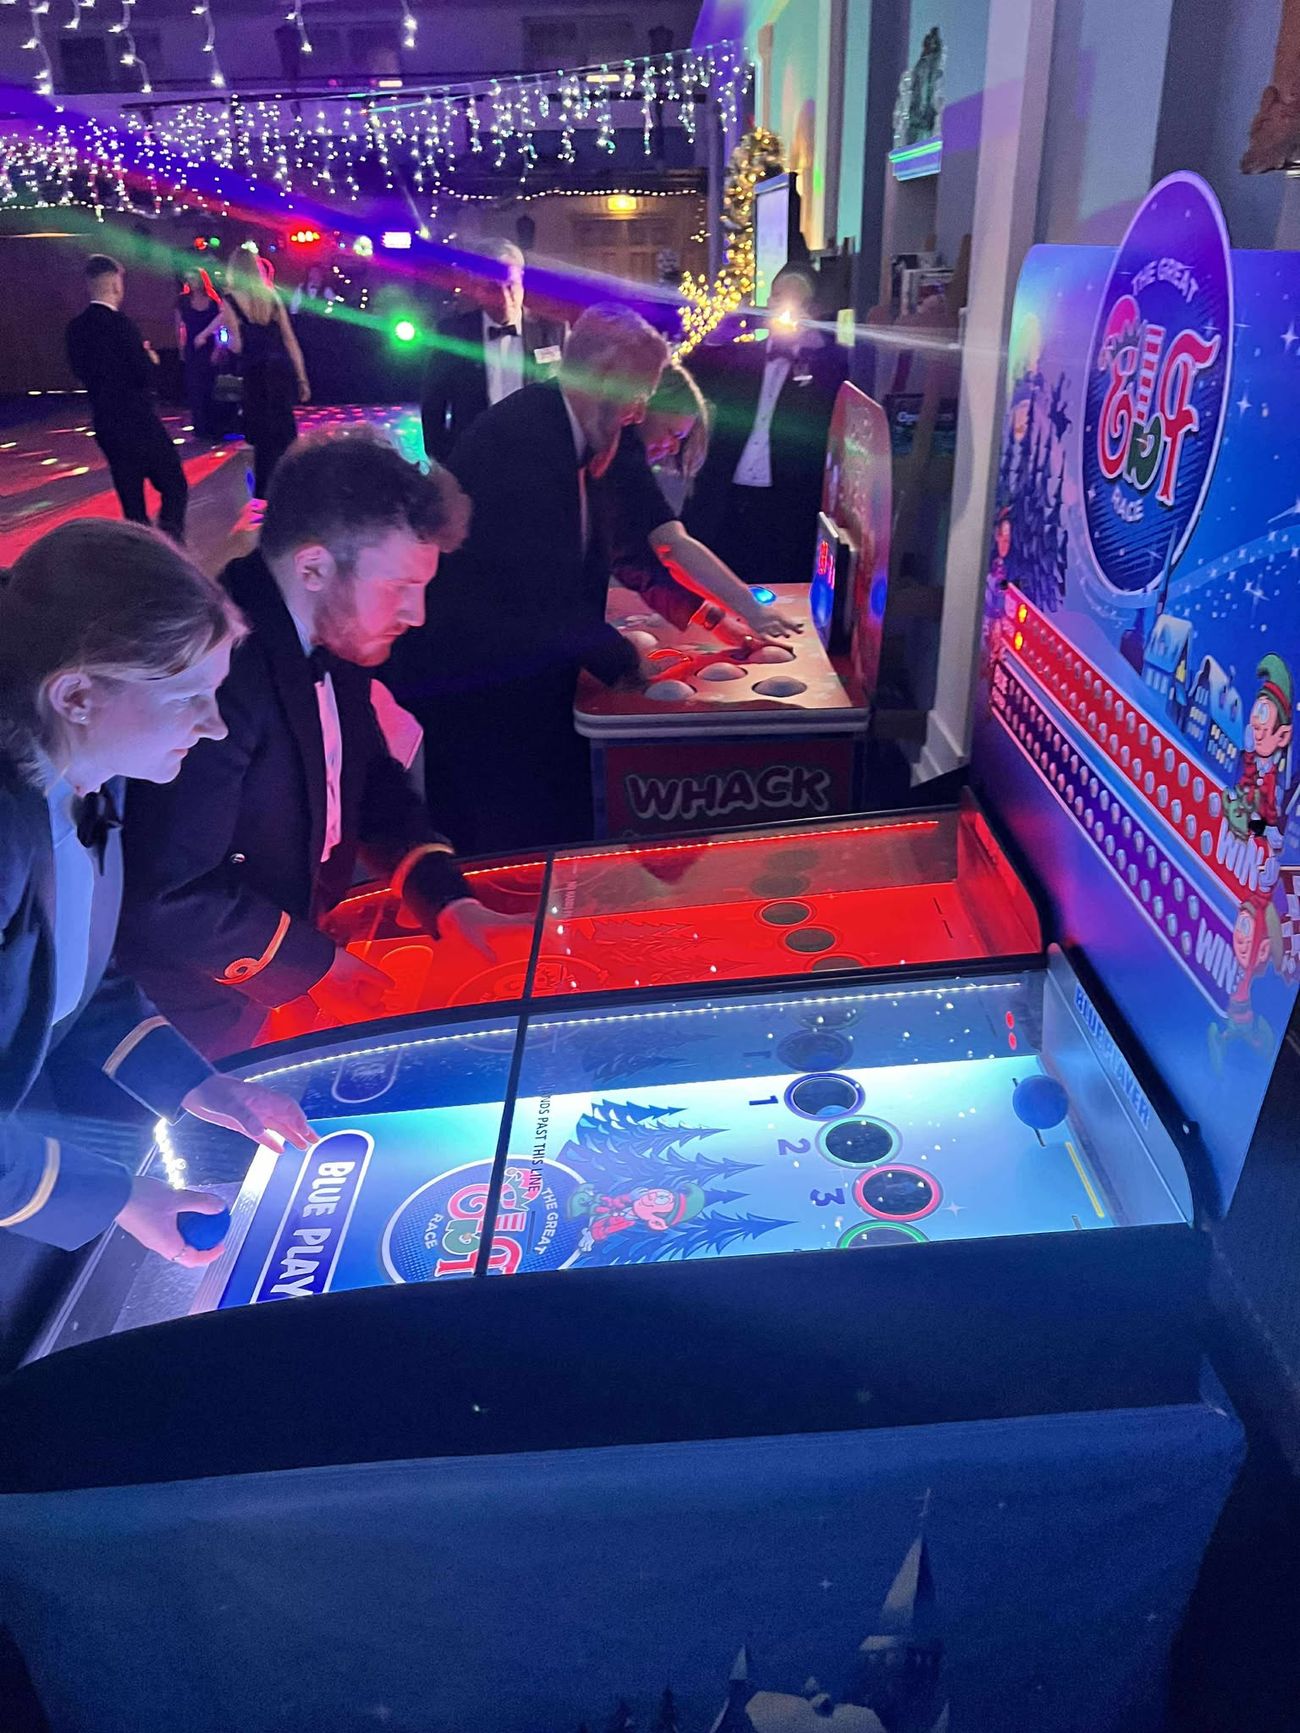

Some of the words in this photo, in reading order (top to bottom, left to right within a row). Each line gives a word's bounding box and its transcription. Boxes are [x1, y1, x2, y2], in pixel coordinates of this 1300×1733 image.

[1131, 260, 1158, 296] THE
[1157, 257, 1199, 303] GREAT
[1111, 486, 1144, 522] RACE
[626, 765, 831, 820] WHACK
[749, 1095, 778, 1106] 1
[535, 1116, 549, 1140] PAST
[532, 1143, 546, 1166] THIS
[777, 1138, 811, 1156] 2
[302, 1161, 356, 1218] BLUE
[528, 1168, 543, 1192] LINE
[541, 1187, 558, 1210] THE
[810, 1188, 845, 1207] 3
[424, 1213, 444, 1249] RACE
[534, 1212, 559, 1255] GREAT
